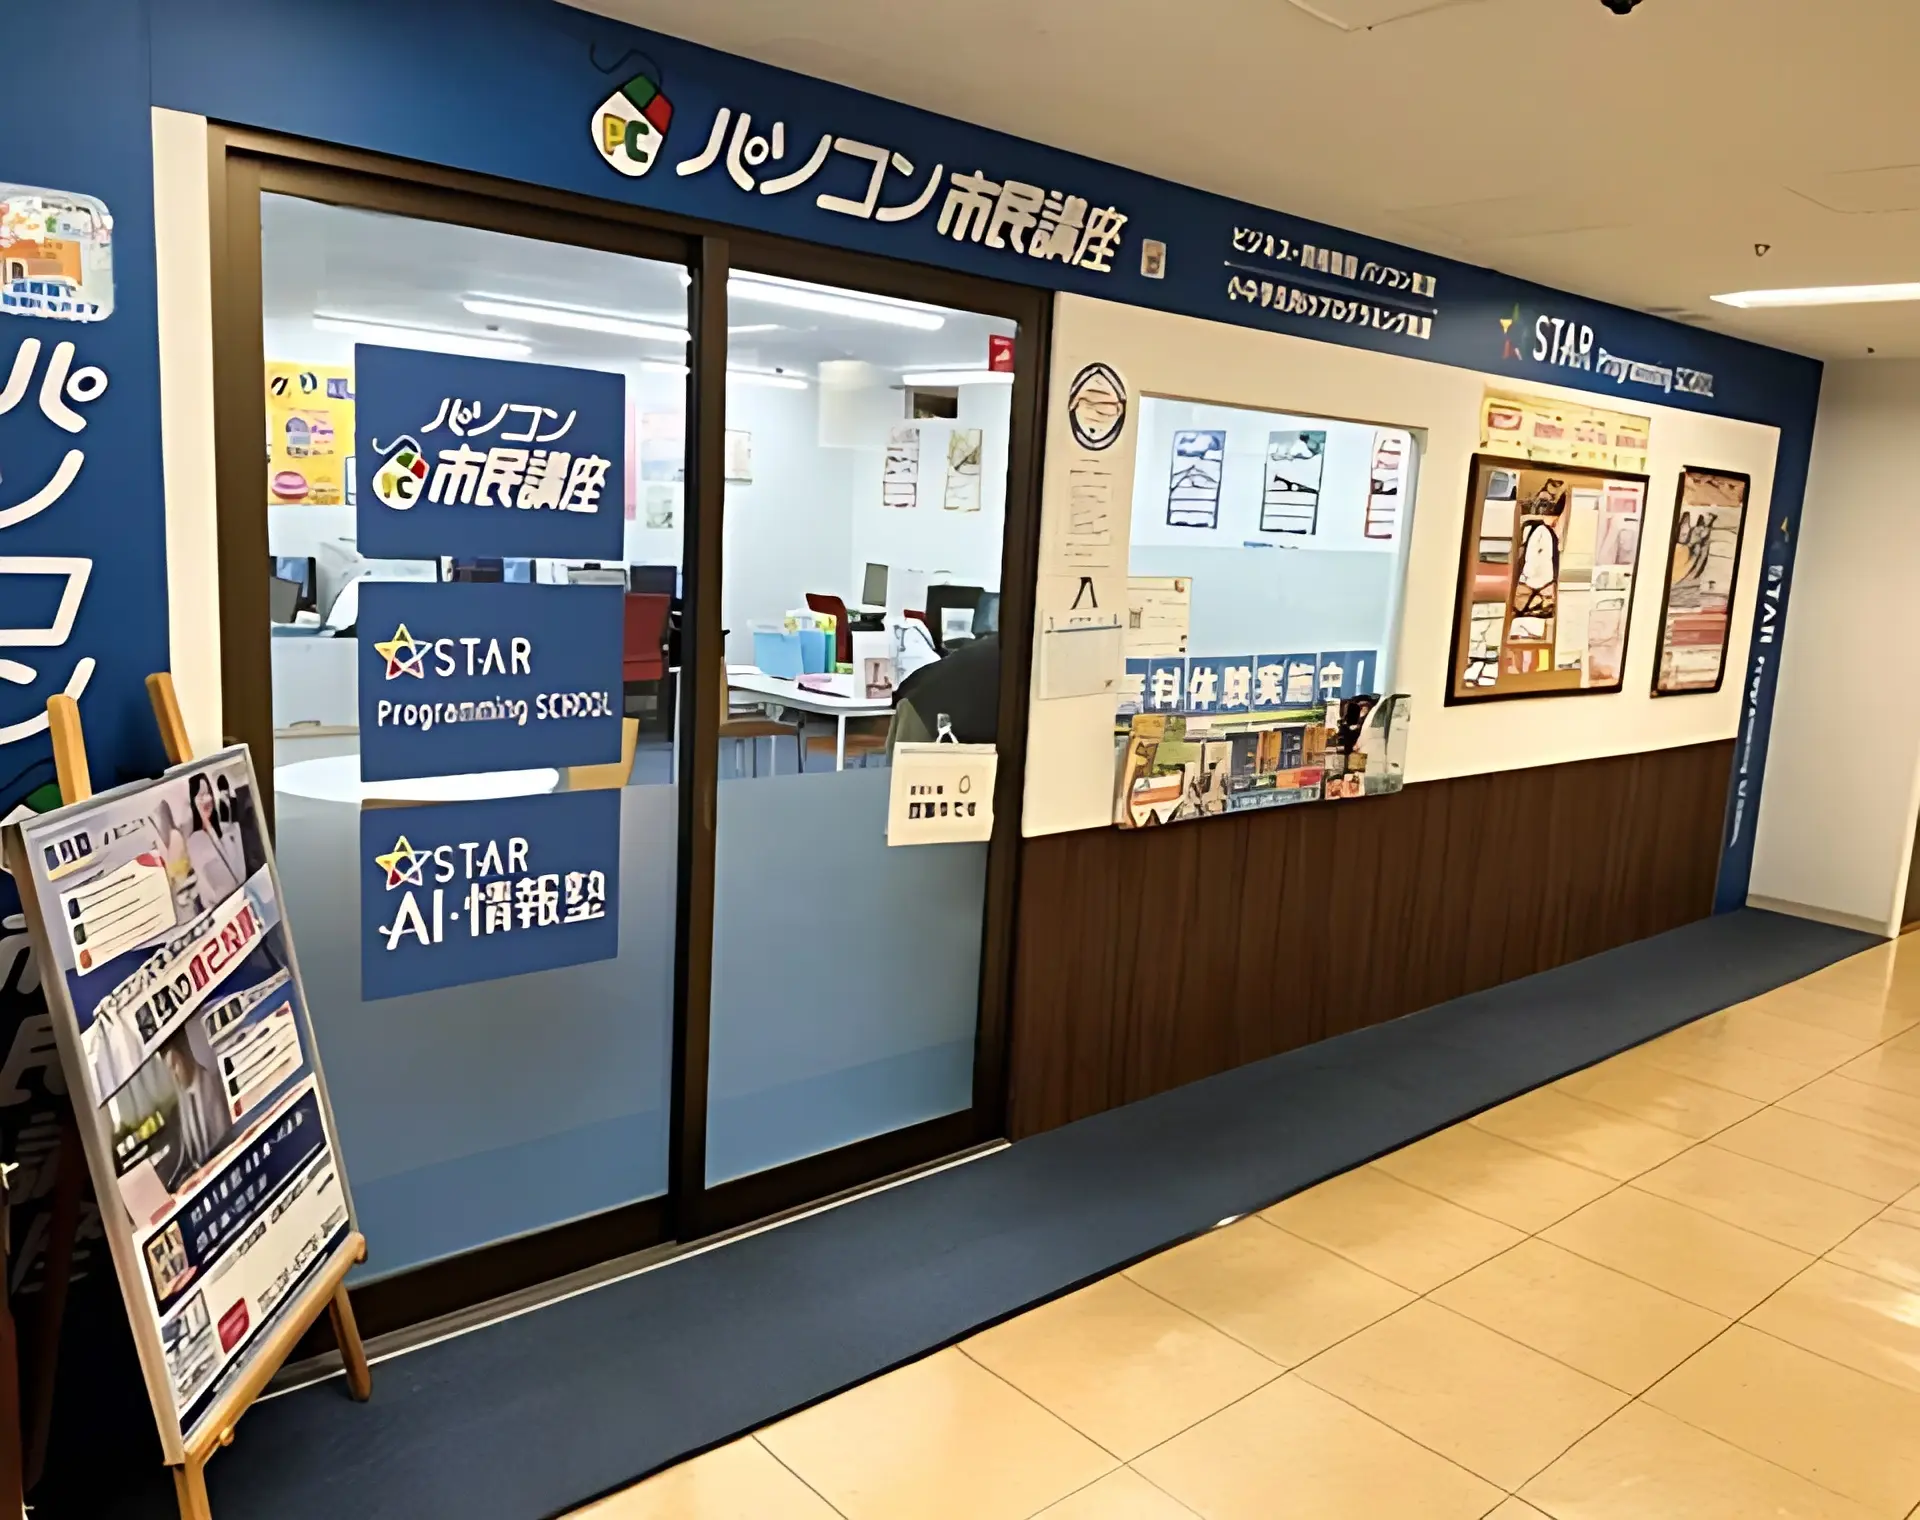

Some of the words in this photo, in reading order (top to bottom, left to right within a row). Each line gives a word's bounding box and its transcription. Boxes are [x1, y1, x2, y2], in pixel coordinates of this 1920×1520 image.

[602, 112, 650, 164] PC
[675, 106, 1129, 273] パソコン市民講座
[1532, 314, 1595, 372] STAR
[420, 397, 578, 443] パソコン
[427, 443, 612, 514] 市民講座
[434, 636, 533, 678] STAR
[434, 836, 530, 884] STAR
